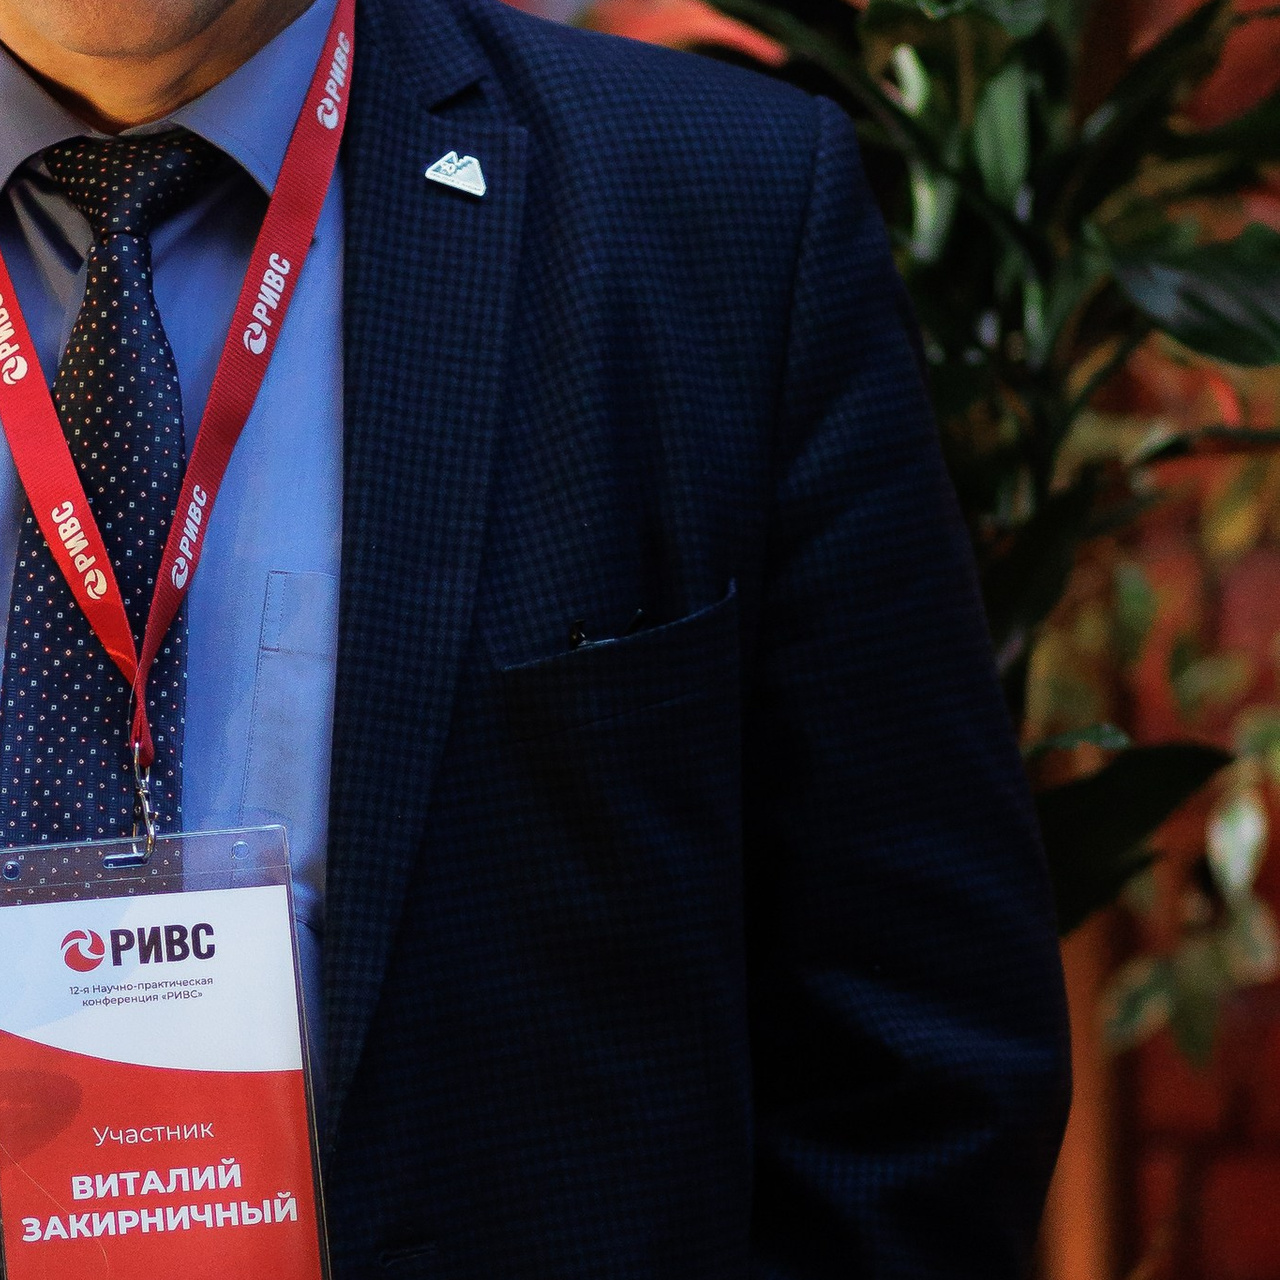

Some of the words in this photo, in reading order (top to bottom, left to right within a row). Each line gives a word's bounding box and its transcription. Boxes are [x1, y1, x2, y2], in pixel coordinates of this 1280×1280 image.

[325, 31, 351, 103] РИВС
[252, 252, 291, 327] РИВС
[51, 500, 97, 574] РИВС
[178, 484, 207, 561] РИВС
[109, 922, 216, 967] РИВС
[69, 985, 90, 995] 12-я
[93, 977, 214, 996] Научно-практическая
[82, 993, 159, 1007] конференция
[161, 989, 203, 1001] «РИВС»
[93, 1122, 215, 1147] Участник
[71, 1157, 242, 1201] ВИТАЛИЙ
[21, 1191, 298, 1243] ЗАКИРНИЧНЫЙ
